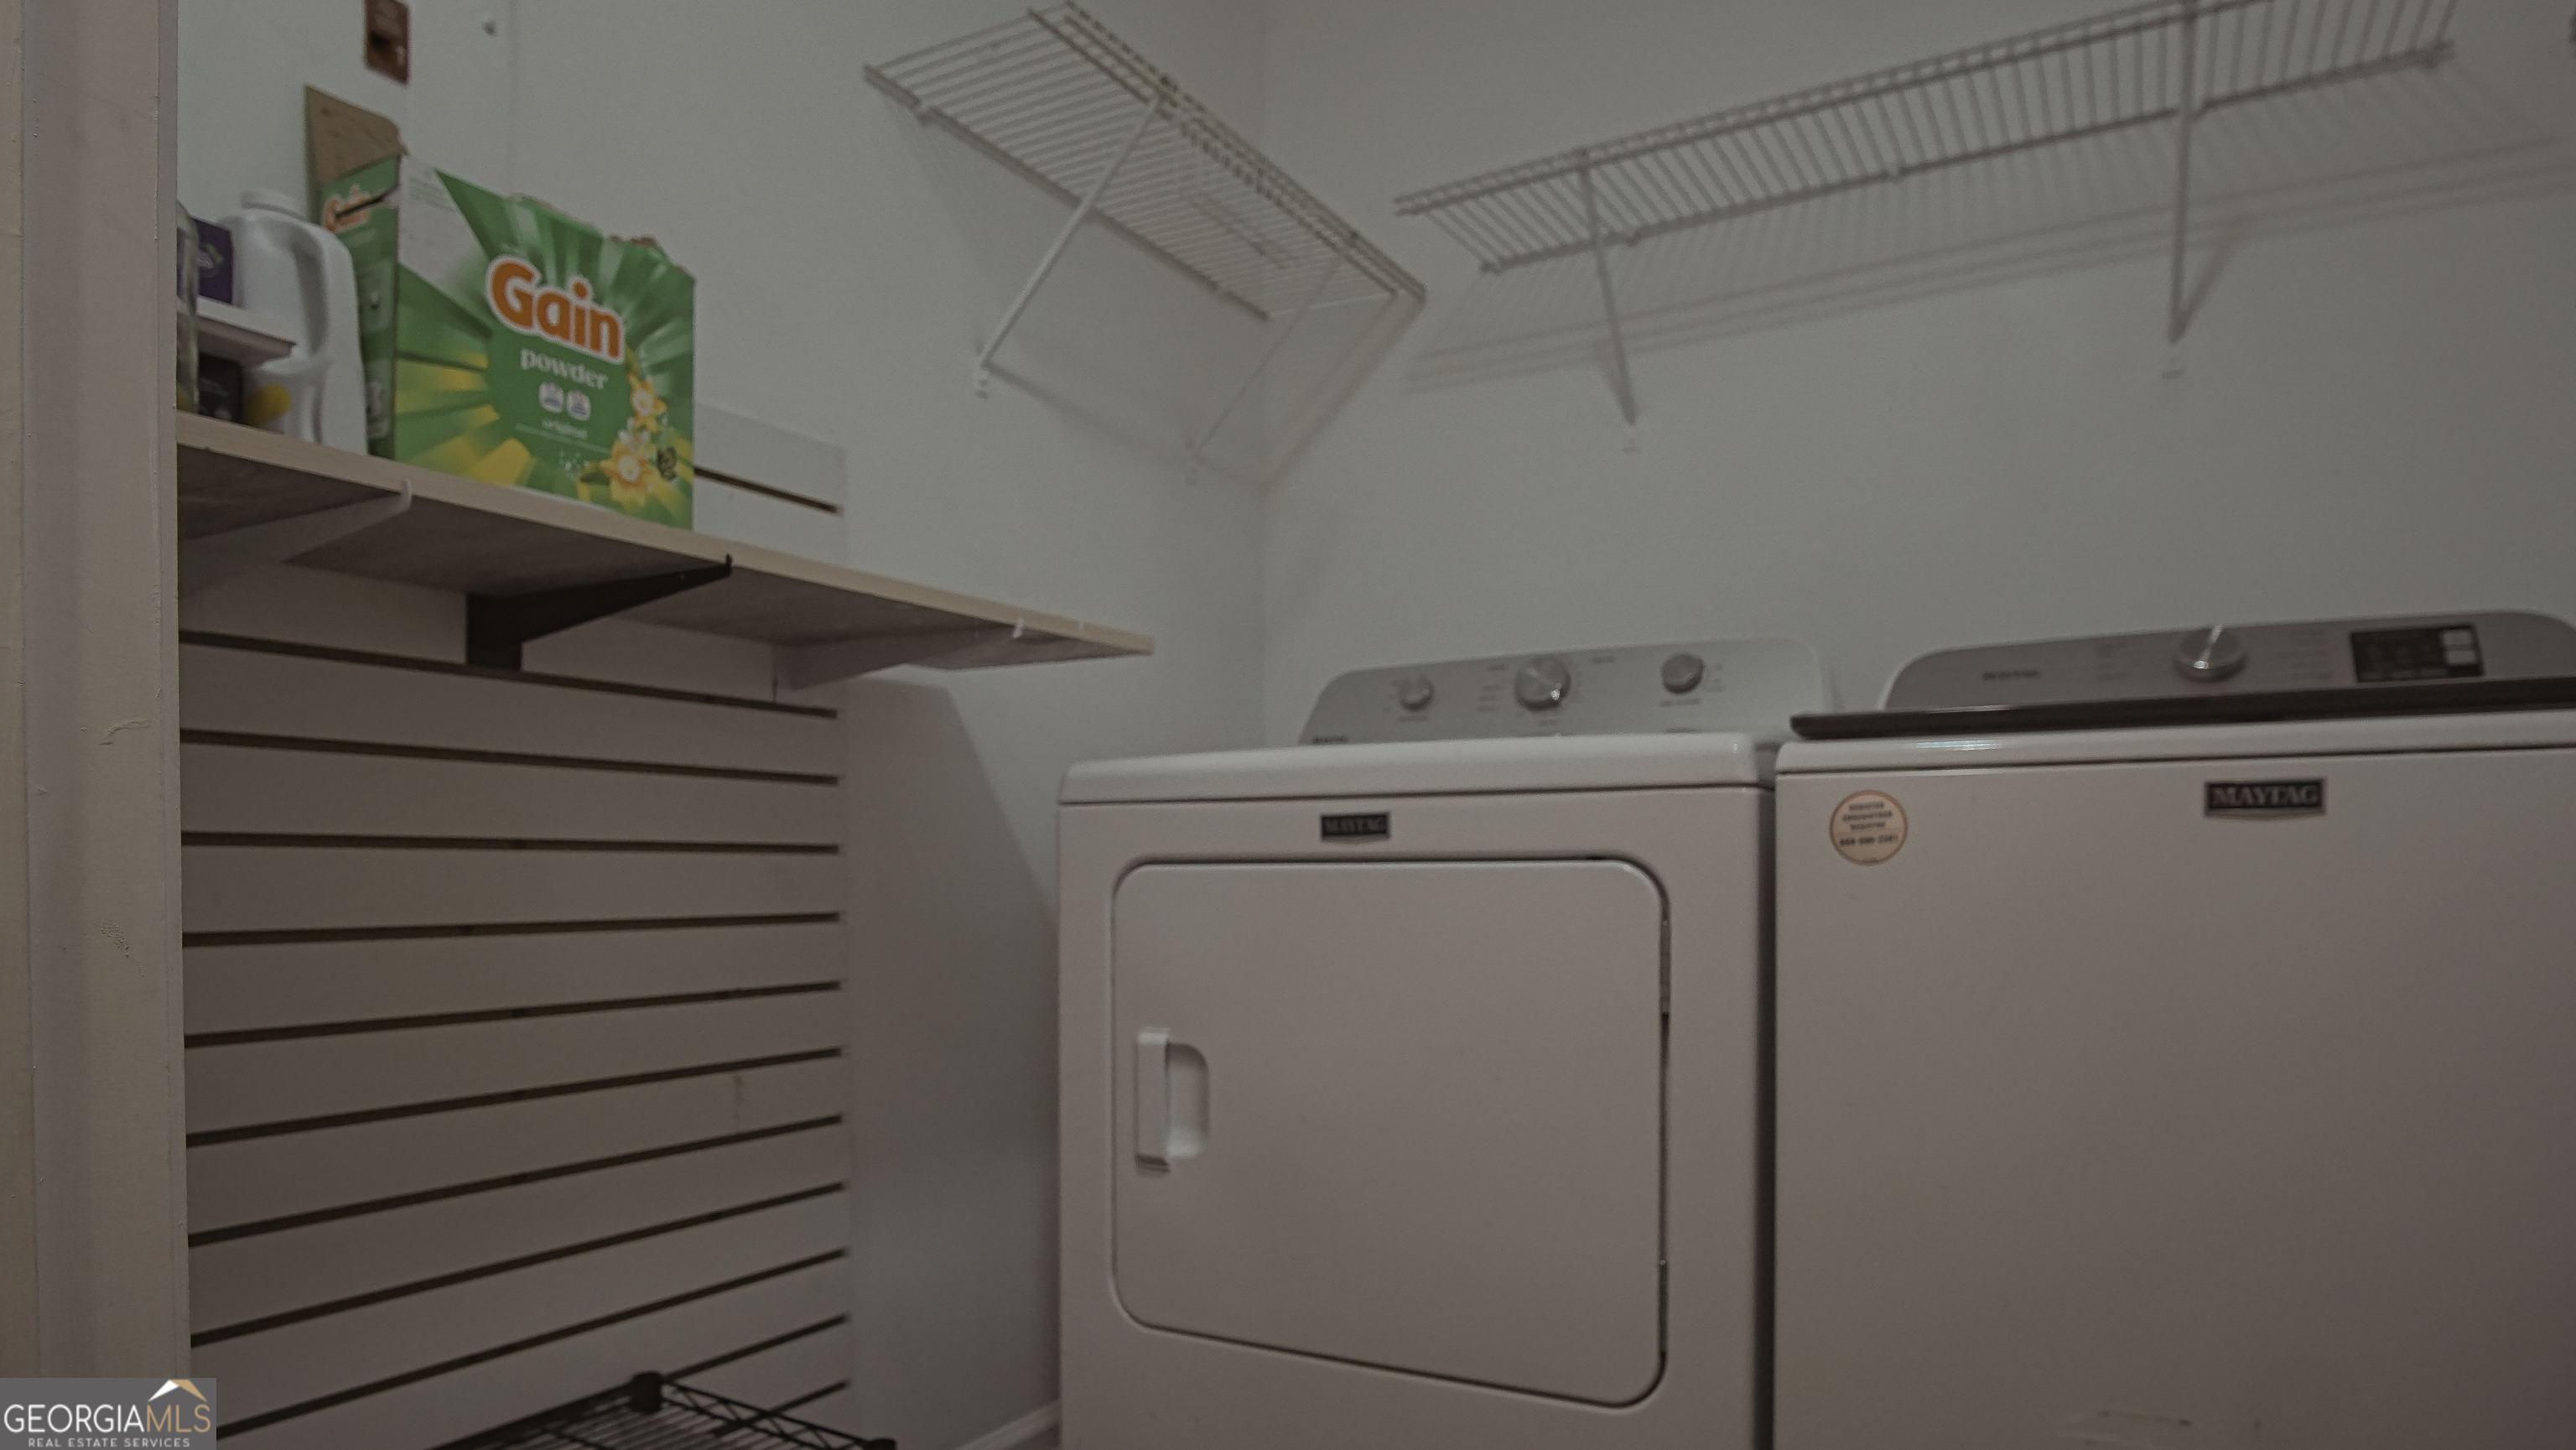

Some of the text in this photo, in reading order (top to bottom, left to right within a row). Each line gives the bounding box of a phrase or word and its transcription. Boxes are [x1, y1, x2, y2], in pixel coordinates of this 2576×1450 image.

[488, 257, 623, 362] Gain
[520, 348, 609, 390] powder
[2212, 787, 2319, 807] MAYTAG
